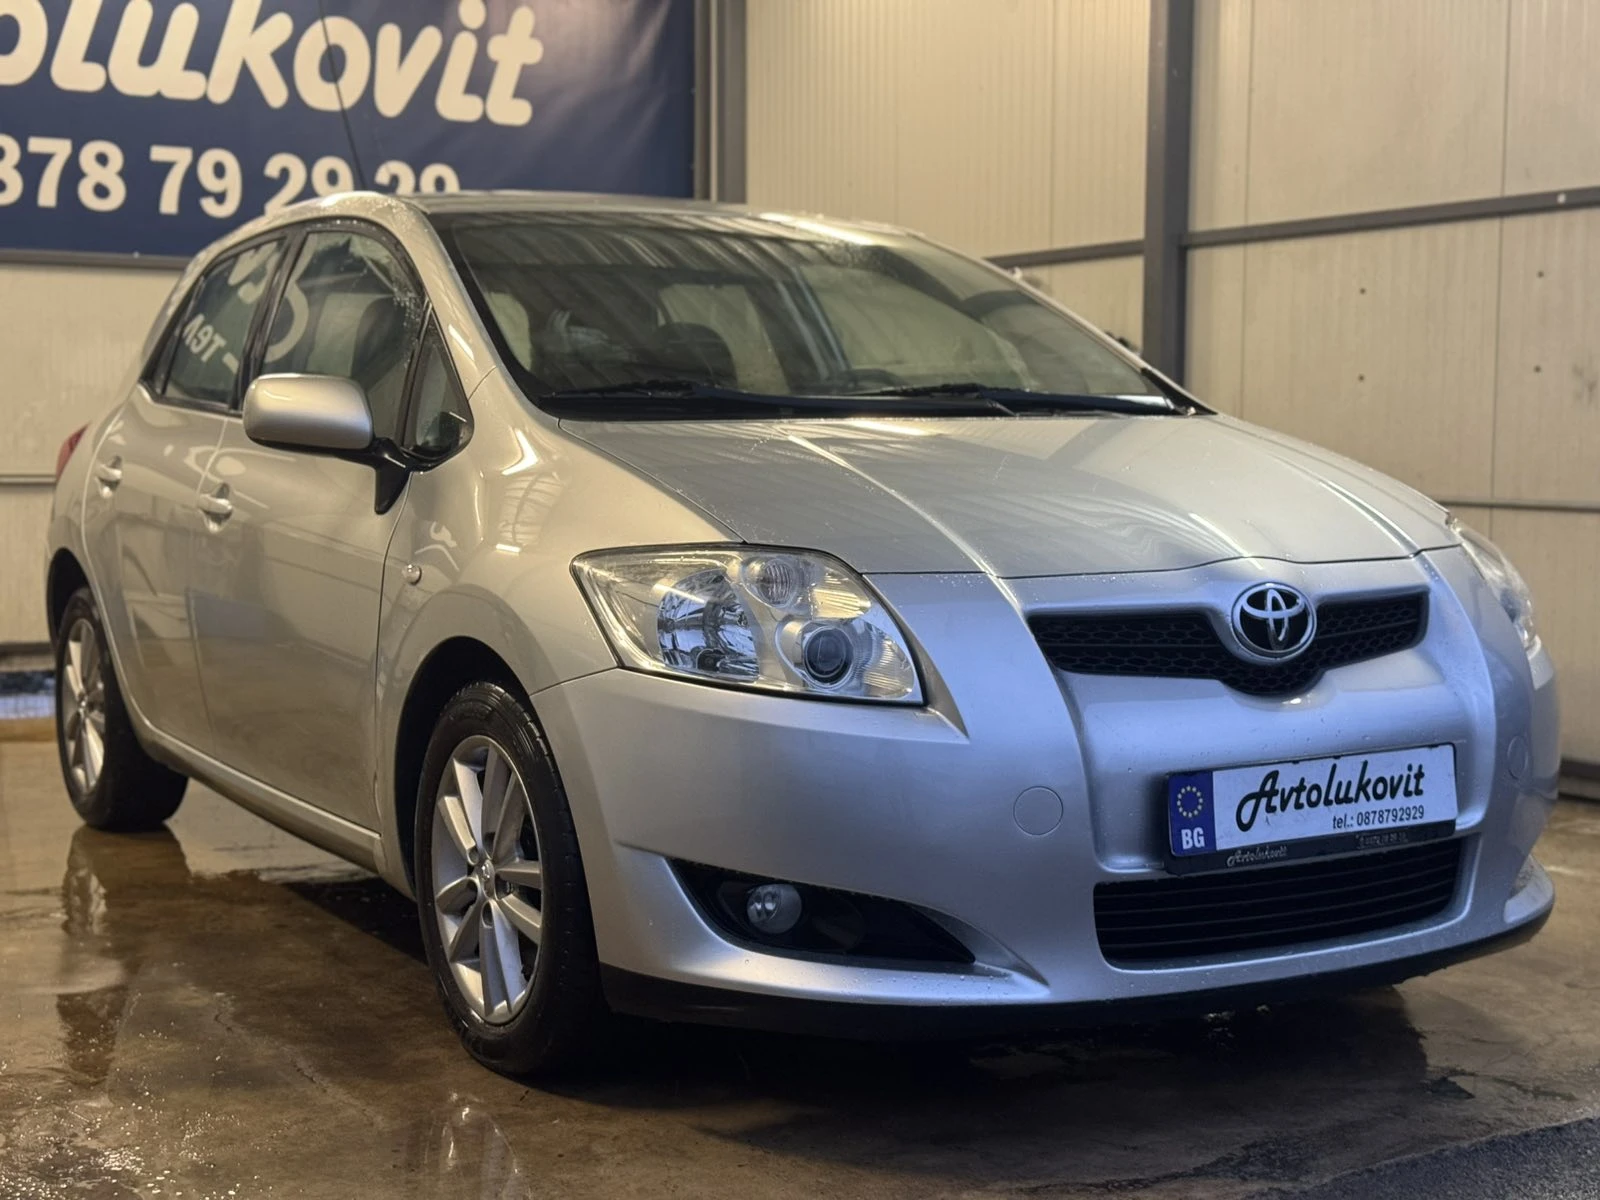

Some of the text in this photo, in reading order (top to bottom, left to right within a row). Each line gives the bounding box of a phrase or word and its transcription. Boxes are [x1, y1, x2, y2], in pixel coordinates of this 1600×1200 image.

[149, 145, 243, 218] 79
[1236, 760, 1425, 832] Avtolukovit
[1332, 804, 1425, 830] tel.: 0878792929
[1181, 827, 1205, 850] BG
